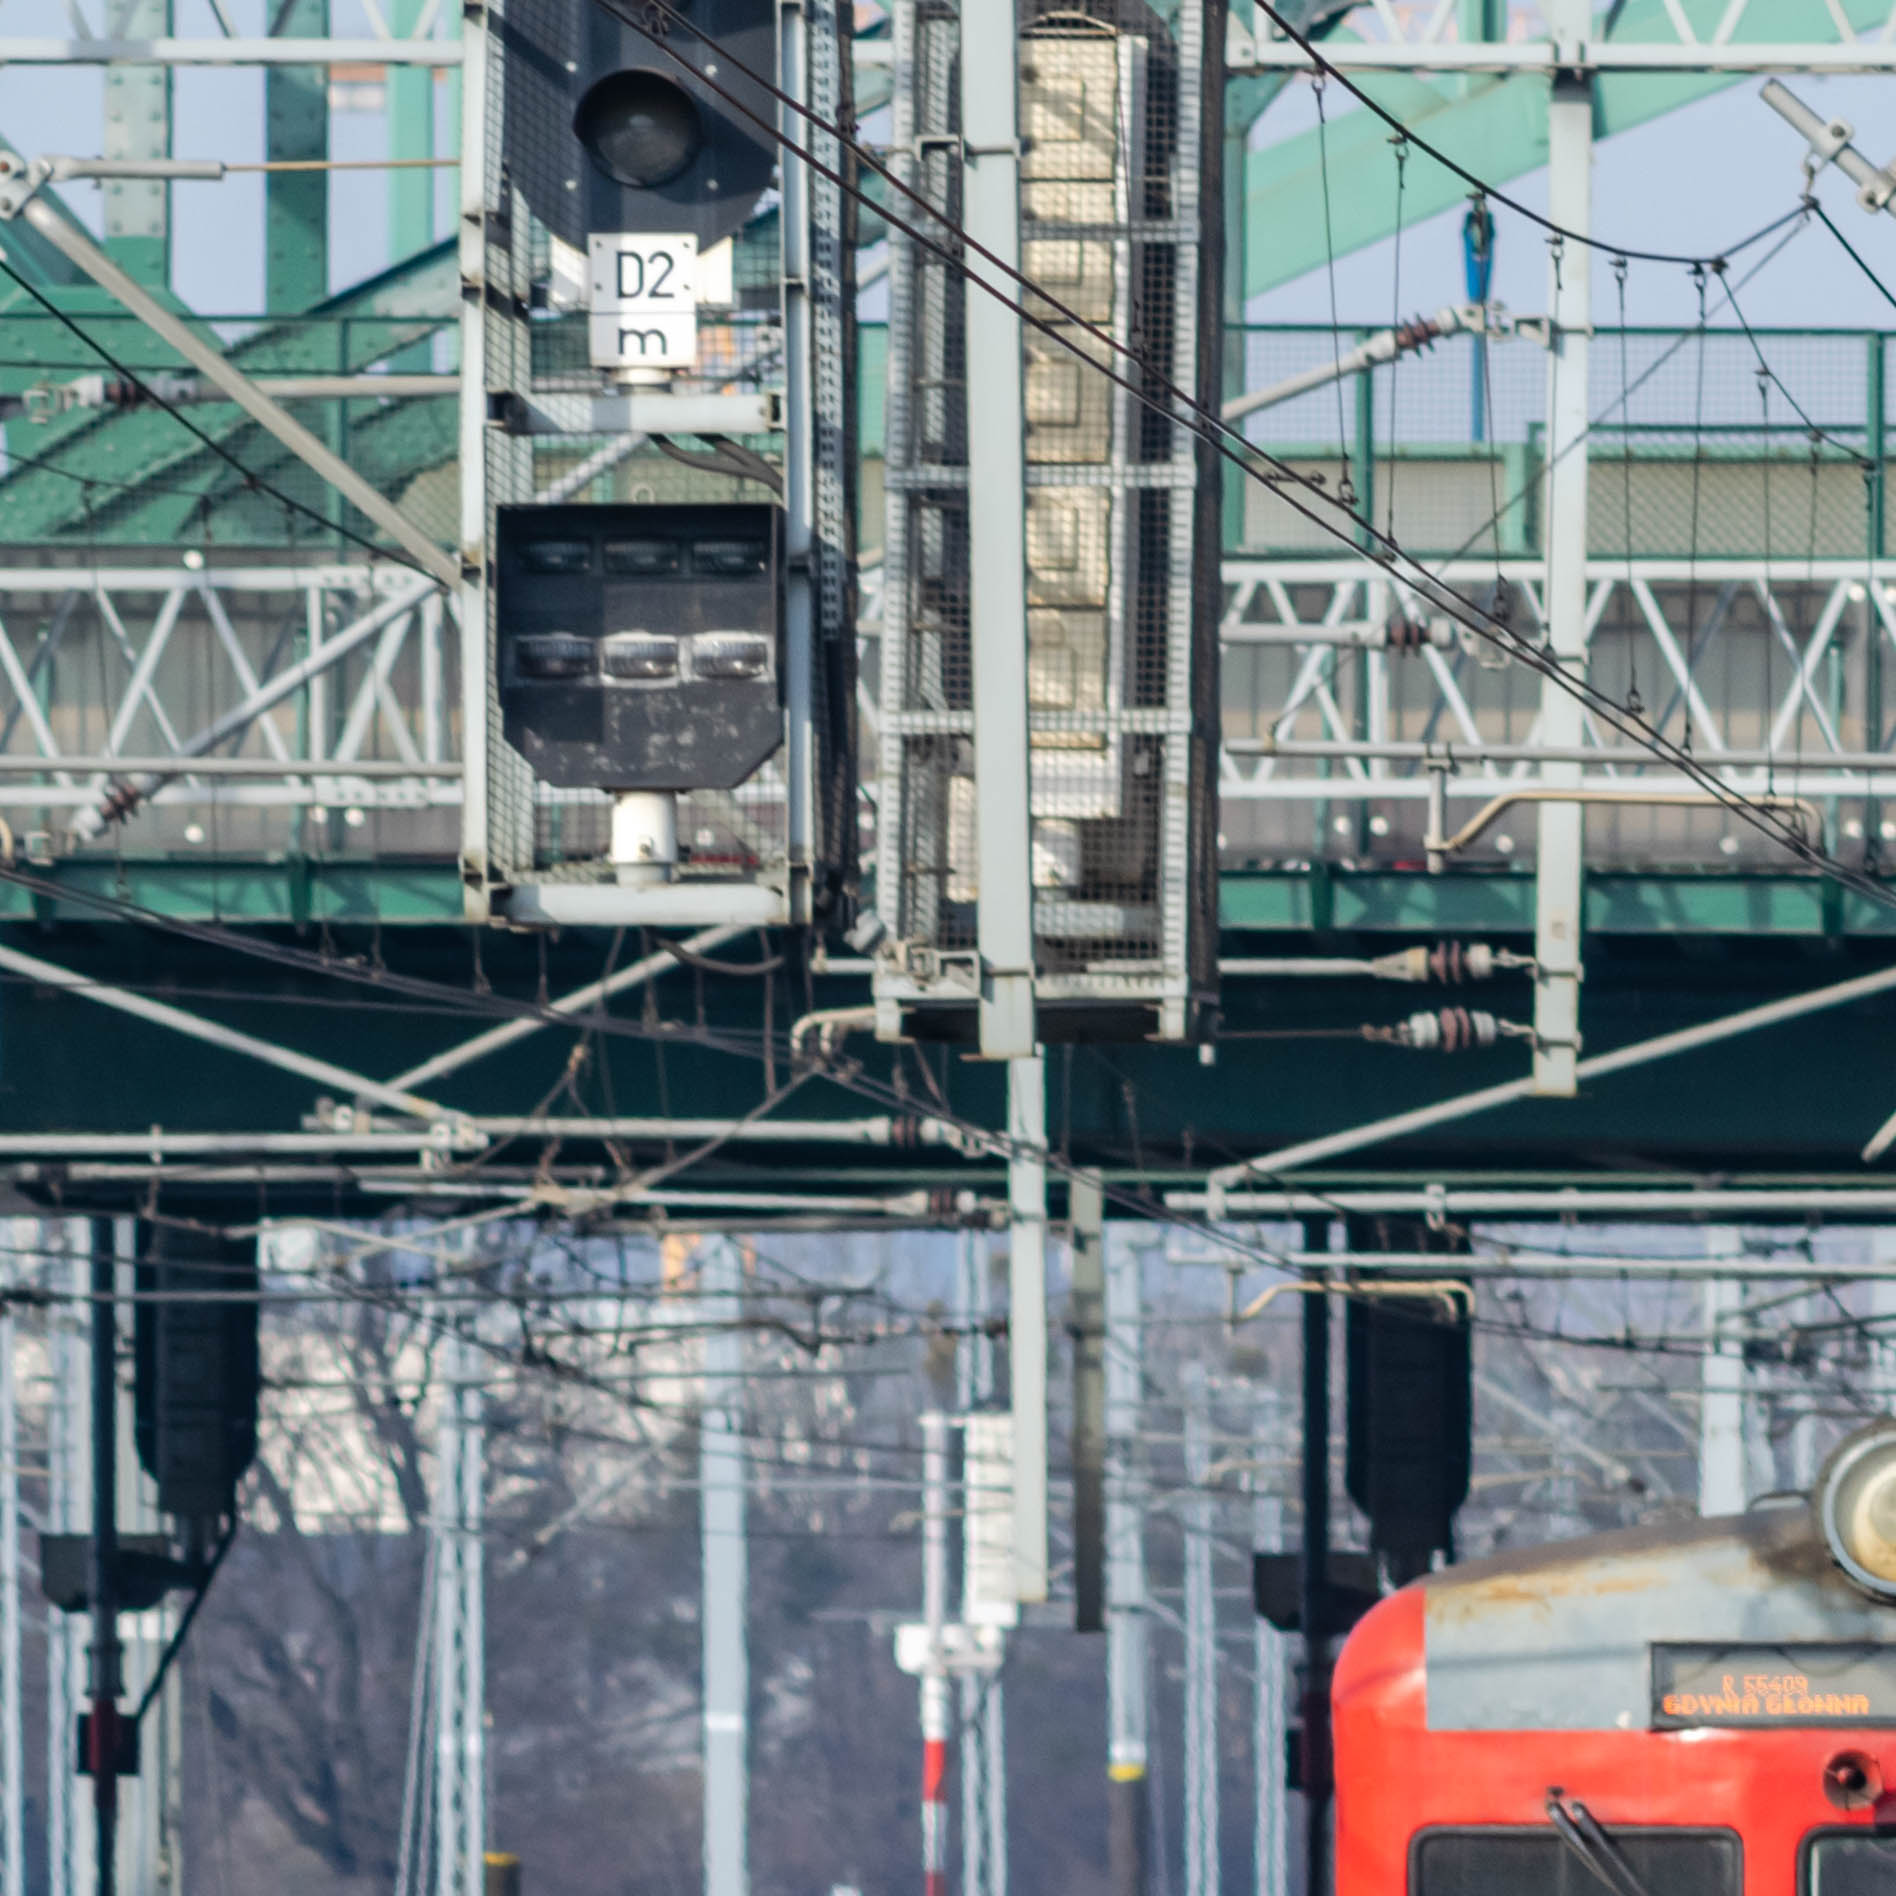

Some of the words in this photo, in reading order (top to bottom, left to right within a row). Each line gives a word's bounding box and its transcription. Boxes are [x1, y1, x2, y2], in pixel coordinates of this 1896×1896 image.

[616, 250, 675, 299] D2
[618, 327, 667, 356] m
[1662, 1694, 1760, 1716] GDYNIA
